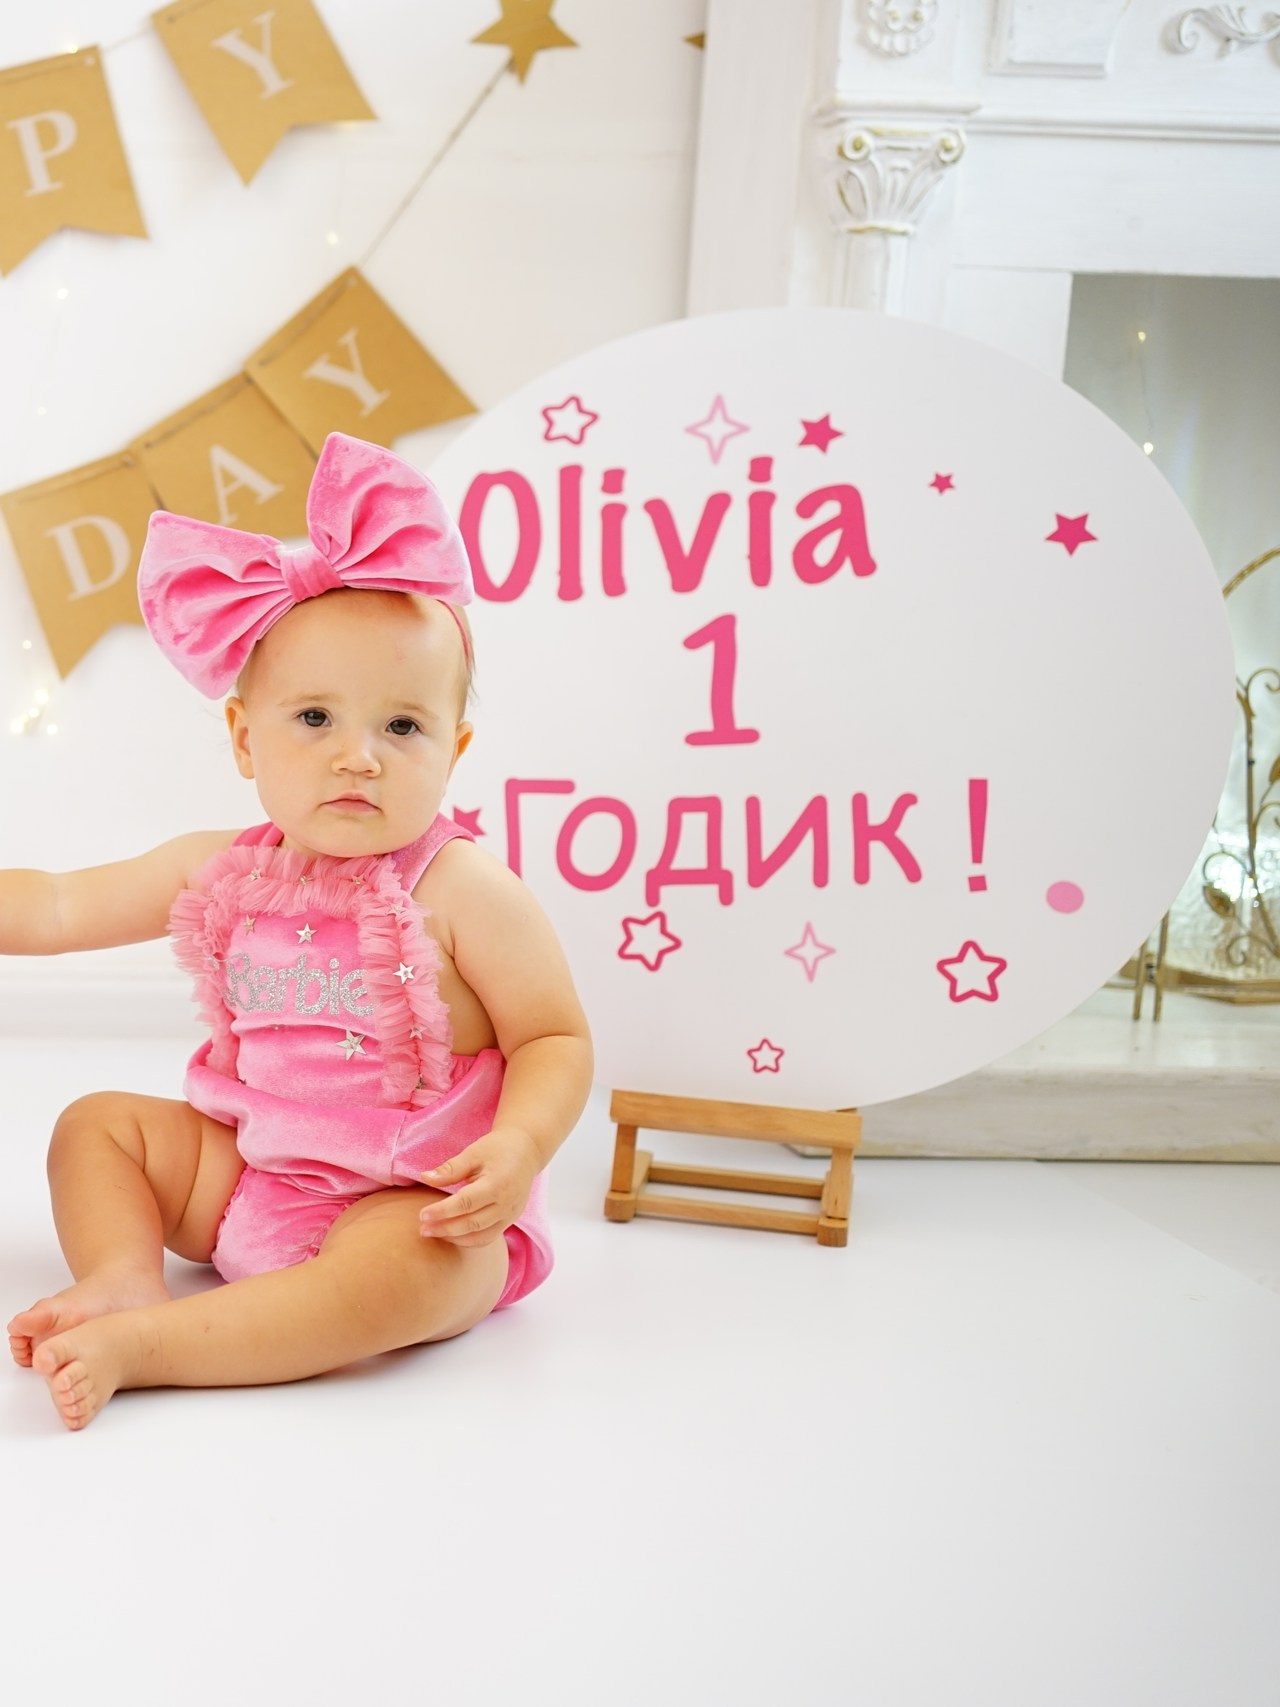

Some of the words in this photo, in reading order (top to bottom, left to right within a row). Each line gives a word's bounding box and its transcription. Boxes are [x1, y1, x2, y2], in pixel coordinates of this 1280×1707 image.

[459, 456, 877, 602] Olivia
[682, 614, 760, 746] 1
[206, 953, 376, 1017] Barbie
